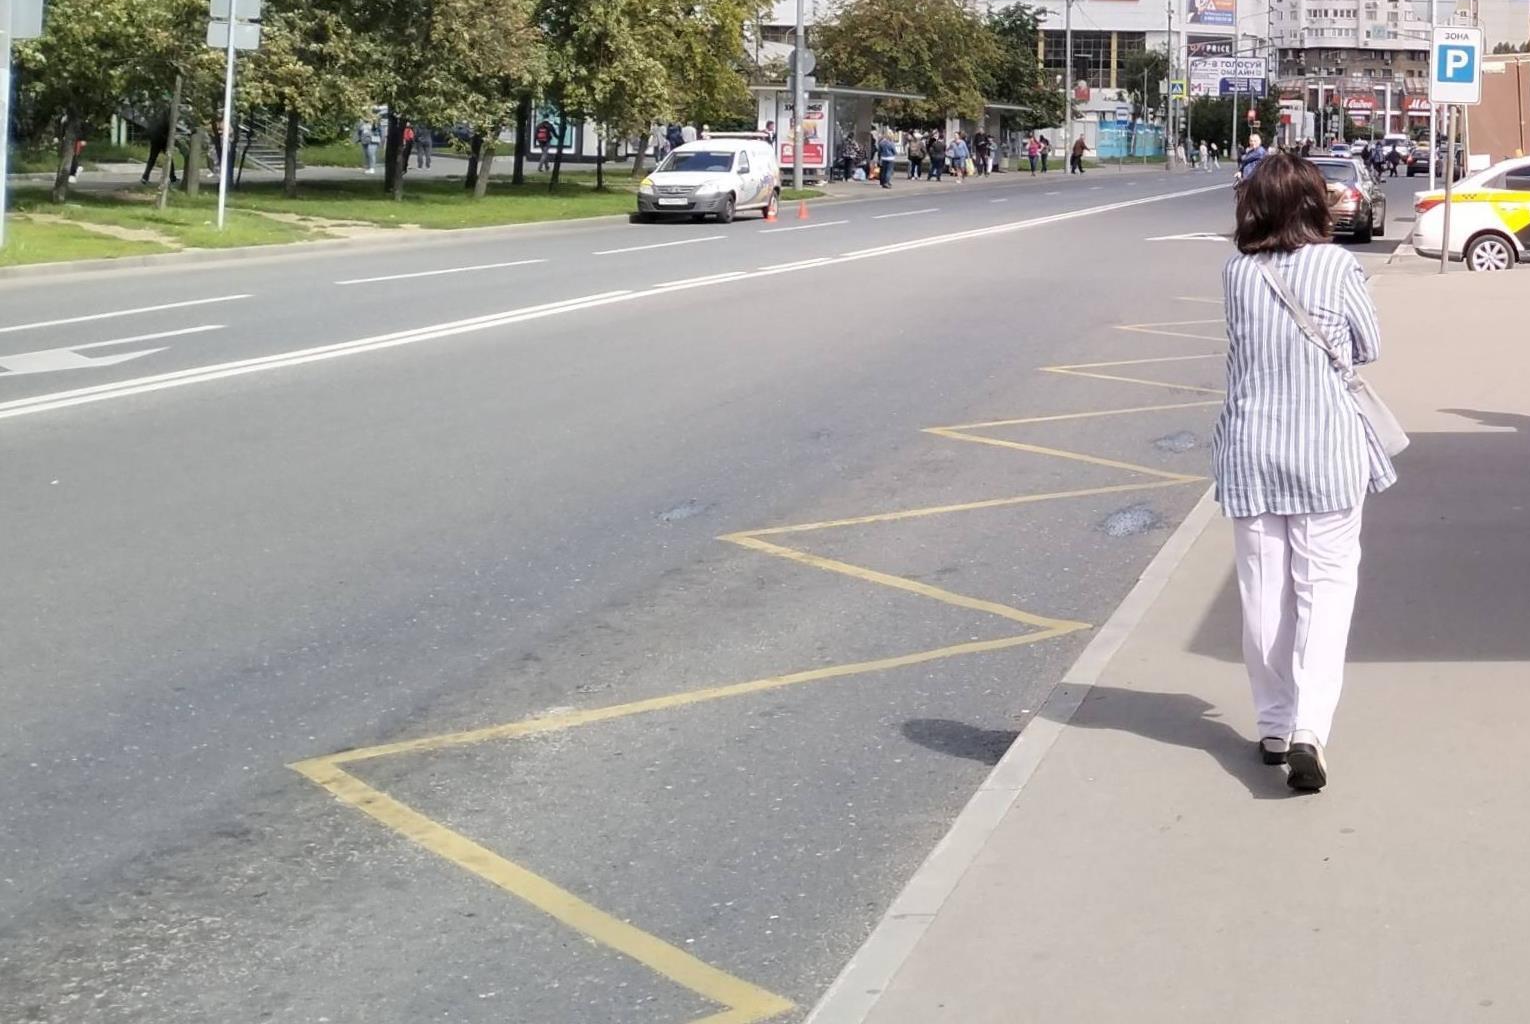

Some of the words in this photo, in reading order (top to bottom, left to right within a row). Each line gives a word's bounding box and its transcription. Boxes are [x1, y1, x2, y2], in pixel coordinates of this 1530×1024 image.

[1444, 32, 1470, 41] ЗОНА
[1206, 44, 1230, 53] PRICE
[1220, 59, 1262, 68] ГОЛОСУЙ
[1446, 49, 1469, 78] P
